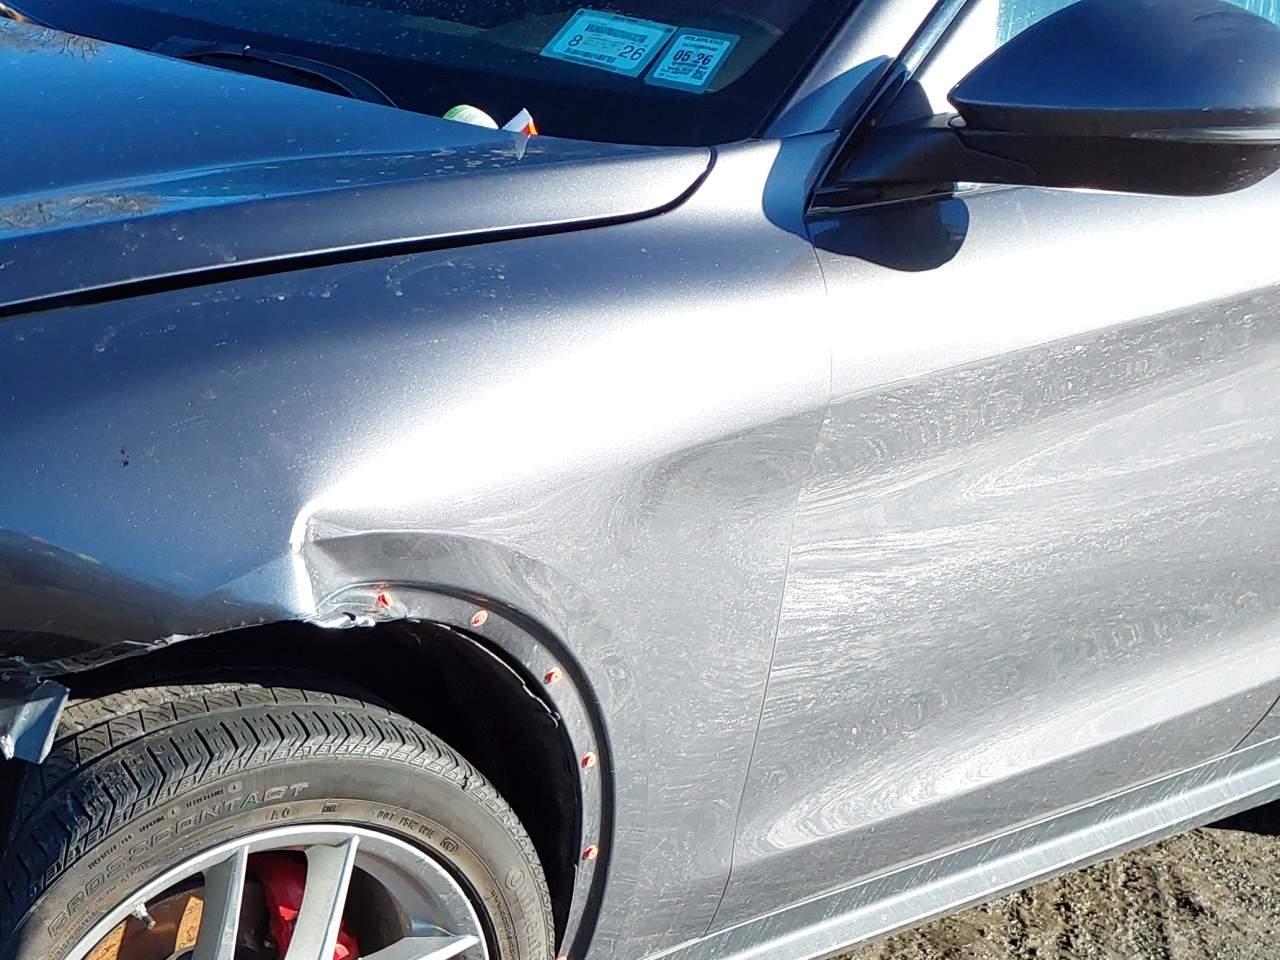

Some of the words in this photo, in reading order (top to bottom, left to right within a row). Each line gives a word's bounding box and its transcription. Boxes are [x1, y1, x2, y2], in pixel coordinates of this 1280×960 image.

[568, 34, 583, 47] 8
[618, 45, 646, 61] 26
[692, 52, 714, 66] 26
